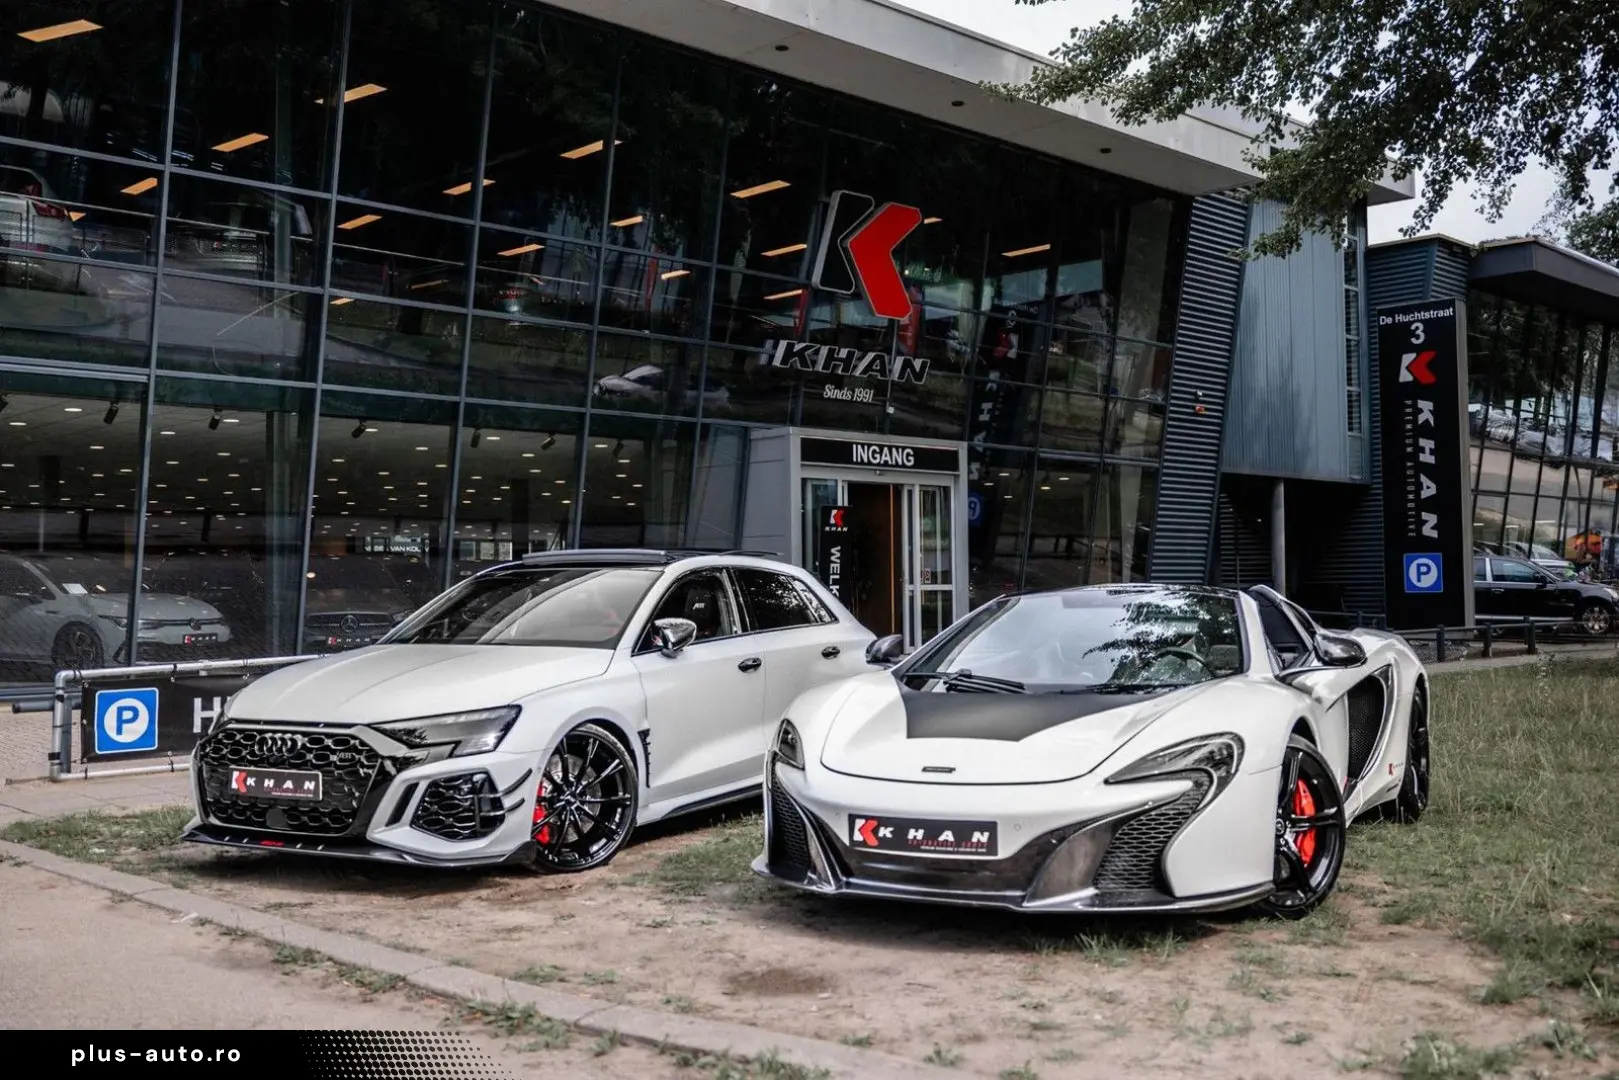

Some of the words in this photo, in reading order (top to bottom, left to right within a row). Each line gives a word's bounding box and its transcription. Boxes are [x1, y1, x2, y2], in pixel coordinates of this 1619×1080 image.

[1379, 316, 1393, 325] De
[1395, 307, 1454, 323] Huchtstraat
[1410, 322, 1425, 345] 3
[772, 339, 930, 384] KHAN
[823, 384, 852, 401] Sinds
[853, 387, 874, 402] 1991
[1404, 400, 1414, 453] PREMIUM
[852, 444, 914, 466] INGANG
[1417, 399, 1439, 539] KHAN
[1406, 461, 1416, 537] AUTOMOTIVE
[1416, 563, 1431, 583] P
[116, 705, 140, 736] P
[246, 776, 316, 791] KHAN
[878, 826, 991, 843] KHAN
